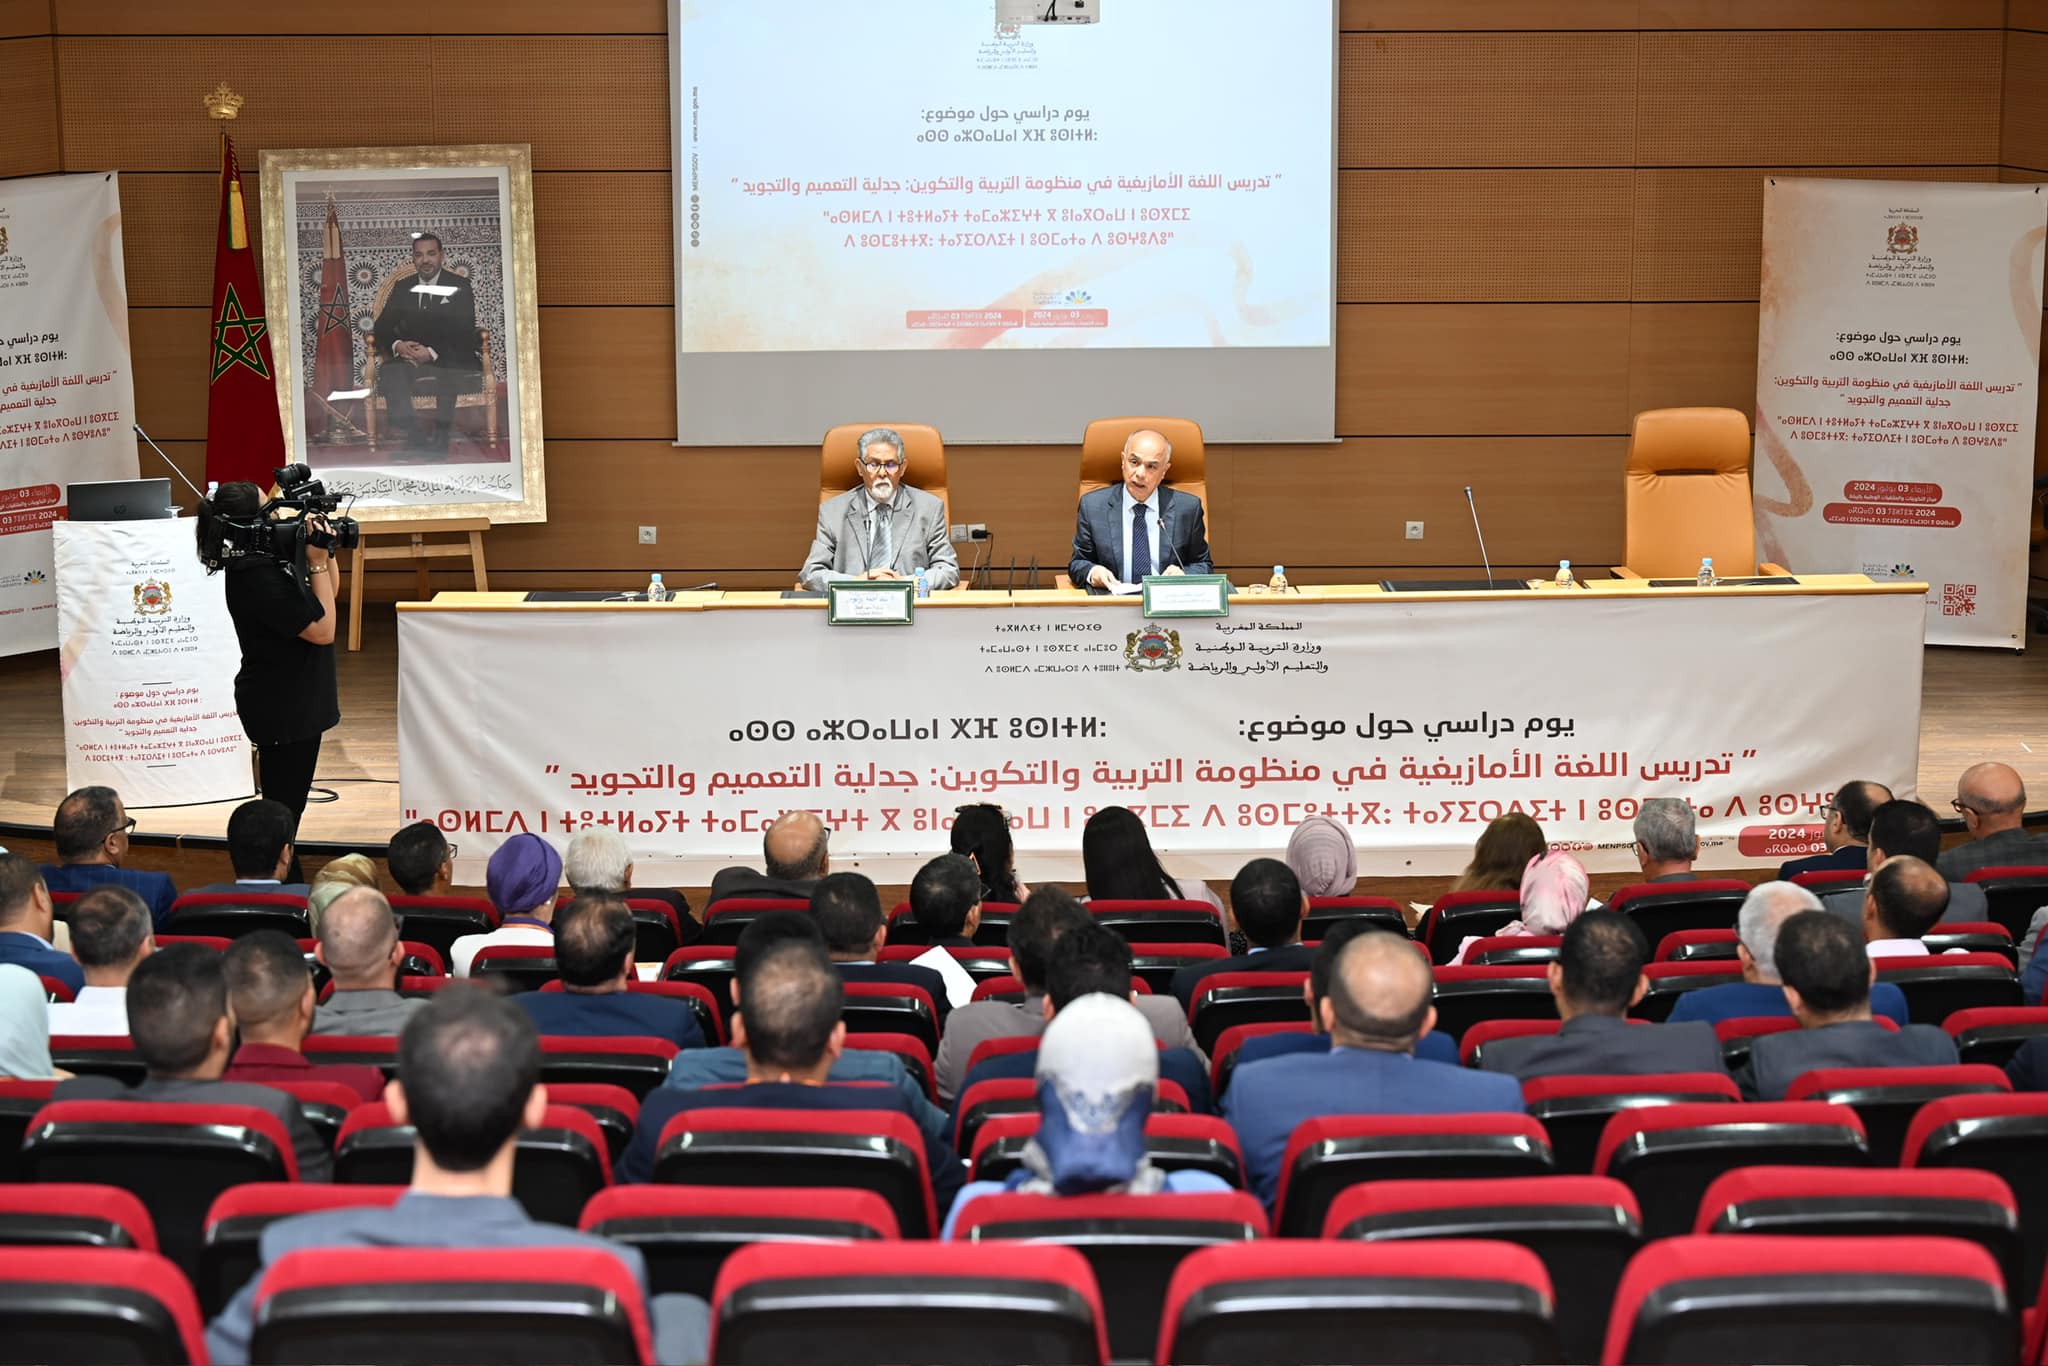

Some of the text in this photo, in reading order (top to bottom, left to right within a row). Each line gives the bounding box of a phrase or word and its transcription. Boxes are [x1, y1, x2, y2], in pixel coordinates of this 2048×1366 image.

[921, 105, 1090, 124] يوم دراسي حول موضوع:
[743, 172, 1272, 196] تدريس اللغة الأمازيغية في منظومة التربية والتكوين: جدلية التعميم والتجويد
[984, 312, 1002, 320] 2024
[8, 332, 38, 348] دراسي
[42, 334, 58, 344] يوم
[1836, 331, 1961, 346] يوم دراسي حول موضوع:
[1774, 375, 2016, 394] تدريس اللغة الأمازيغية في منظومة التربية والتكوين:
[1847, 395, 1951, 408] جدلية التعميم والتجويد
[20, 490, 30, 498] 03
[1854, 483, 1909, 492] 03 2024
[2, 517, 12, 525] 03
[39, 510, 58, 520] 2024
[1876, 508, 1936, 518] 03 2024
[1238, 712, 1575, 742] يوم دراسي حول موضوع:
[570, 748, 1732, 797] تدريس اللغة الأمازيغية في منظومة التربية والتكوين: جدلية التعميم والتجويد
[1769, 828, 1806, 840] 2024
[1810, 842, 1828, 853] 03
